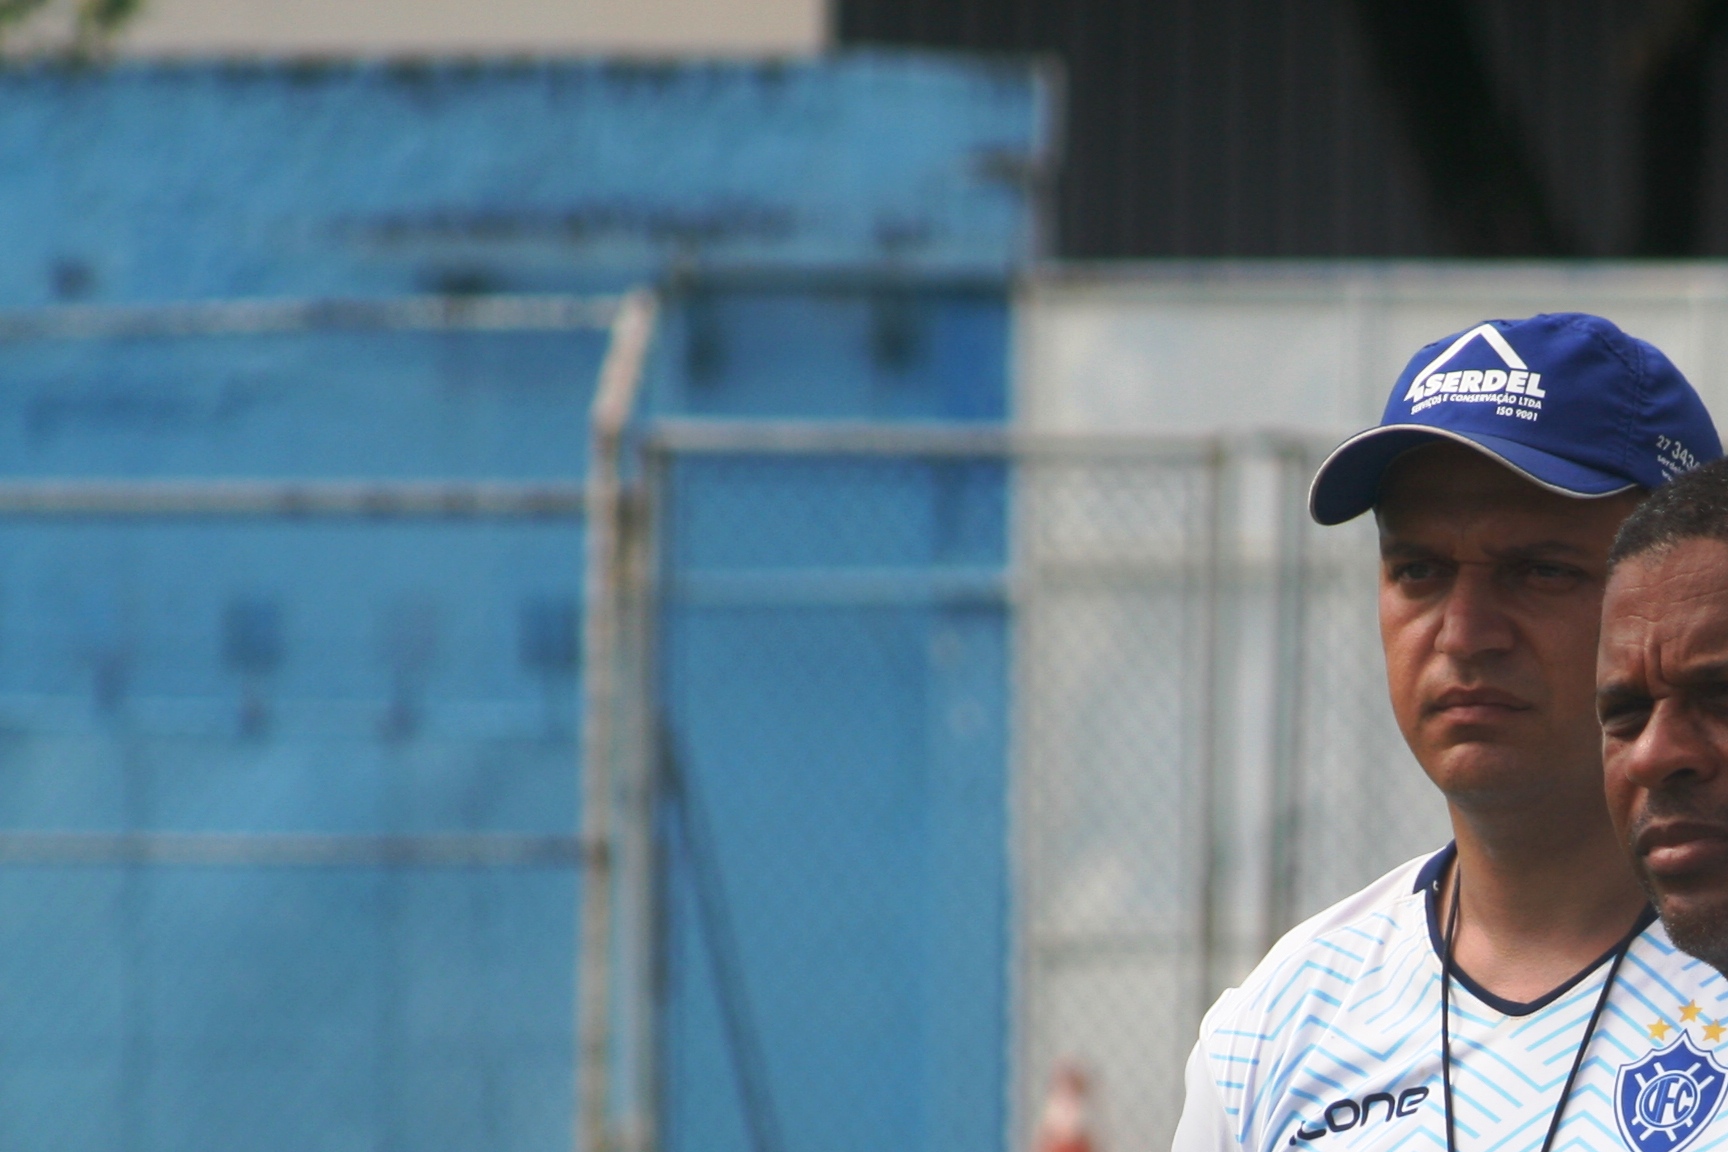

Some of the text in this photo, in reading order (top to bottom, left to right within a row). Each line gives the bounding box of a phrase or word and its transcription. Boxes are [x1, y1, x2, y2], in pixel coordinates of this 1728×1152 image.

[1424, 370, 1546, 398] SERDEL
[1450, 393, 1516, 404] CONSERVAÇÃO
[1518, 397, 1542, 409] LTDA
[1496, 406, 1538, 421] ISO 9001
[1656, 434, 1671, 450] 27
